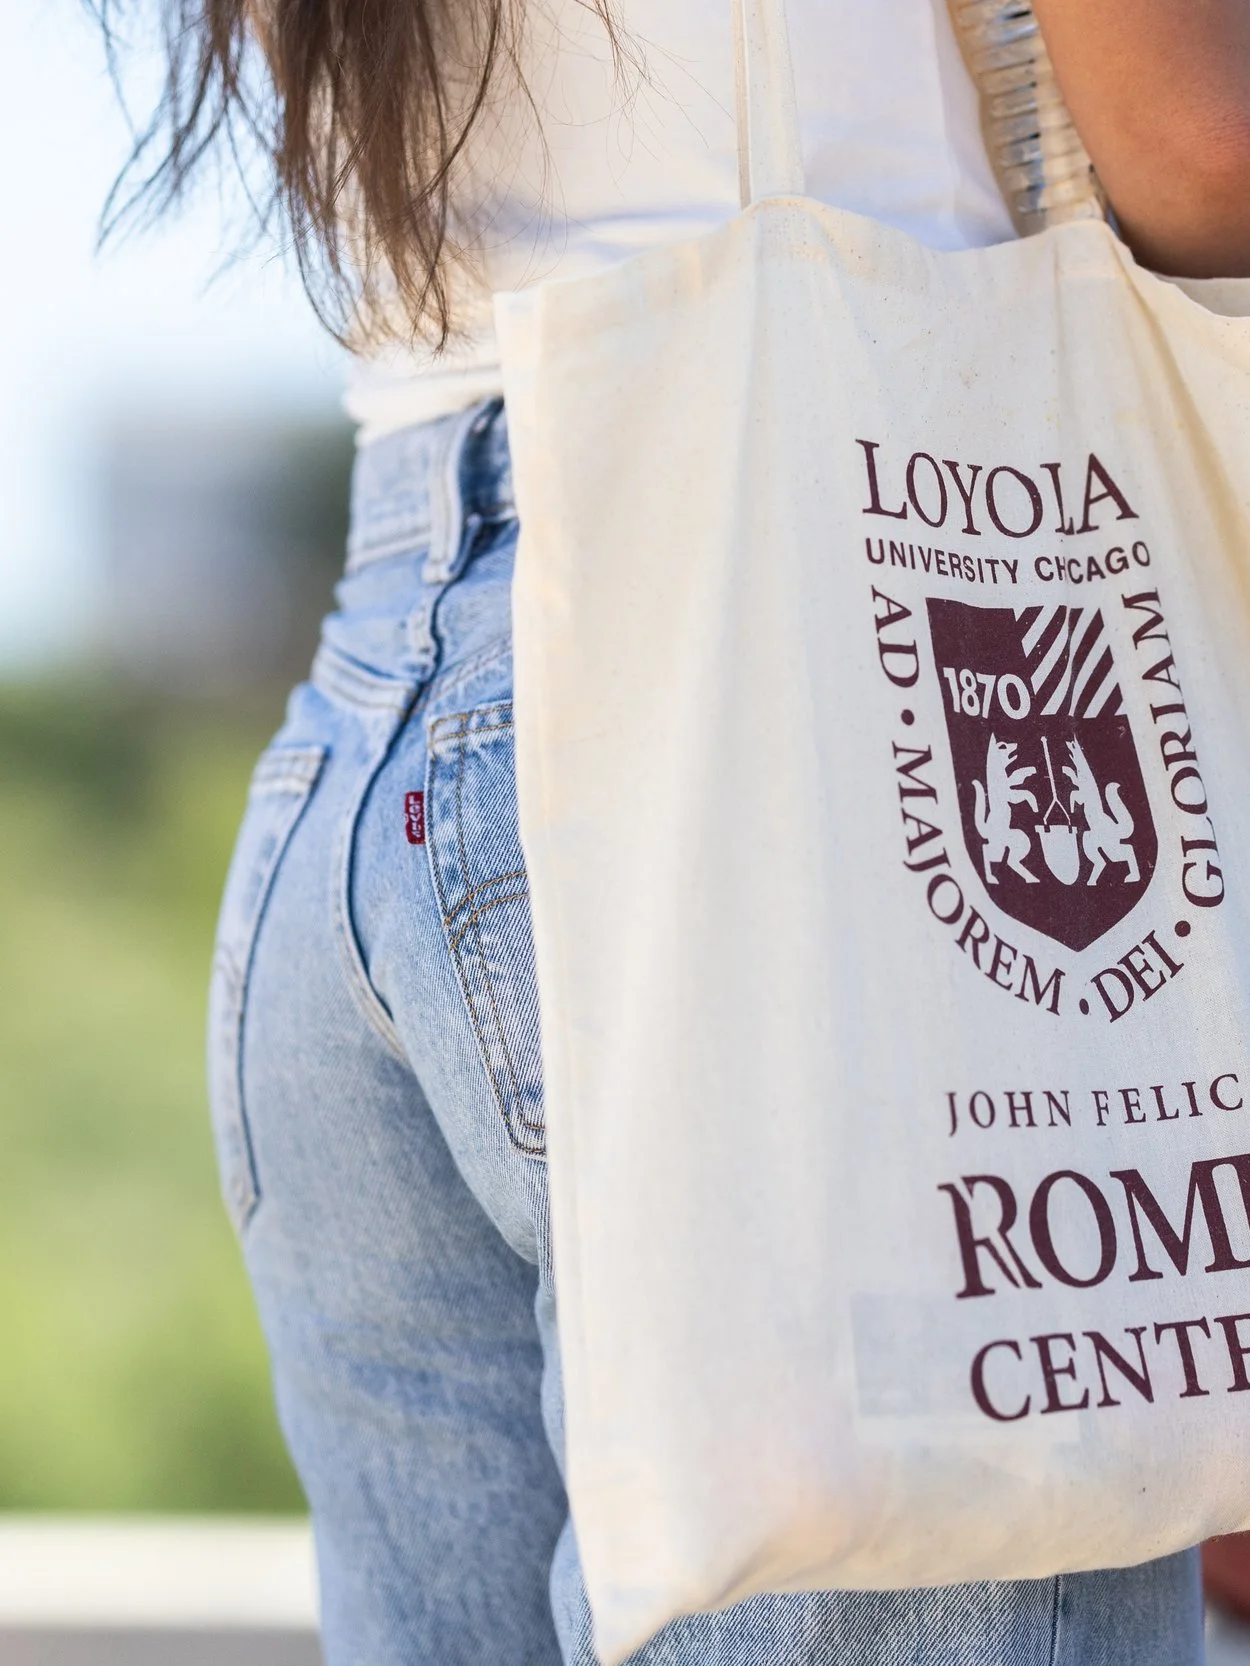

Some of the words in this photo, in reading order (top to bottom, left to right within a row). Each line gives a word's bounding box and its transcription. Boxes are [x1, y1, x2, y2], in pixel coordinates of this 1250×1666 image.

[856, 438, 1140, 539] LOYOLA
[865, 537, 1019, 584] UNIVERSITY
[1034, 540, 1151, 585] CHCAGO
[871, 584, 921, 689] AD
[943, 667, 1031, 720] 1870
[1121, 587, 1225, 908] GLORIAM
[892, 741, 1066, 1016] MAJOREM
[1090, 930, 1185, 1023] DEI
[945, 1091, 1072, 1137] JOHN
